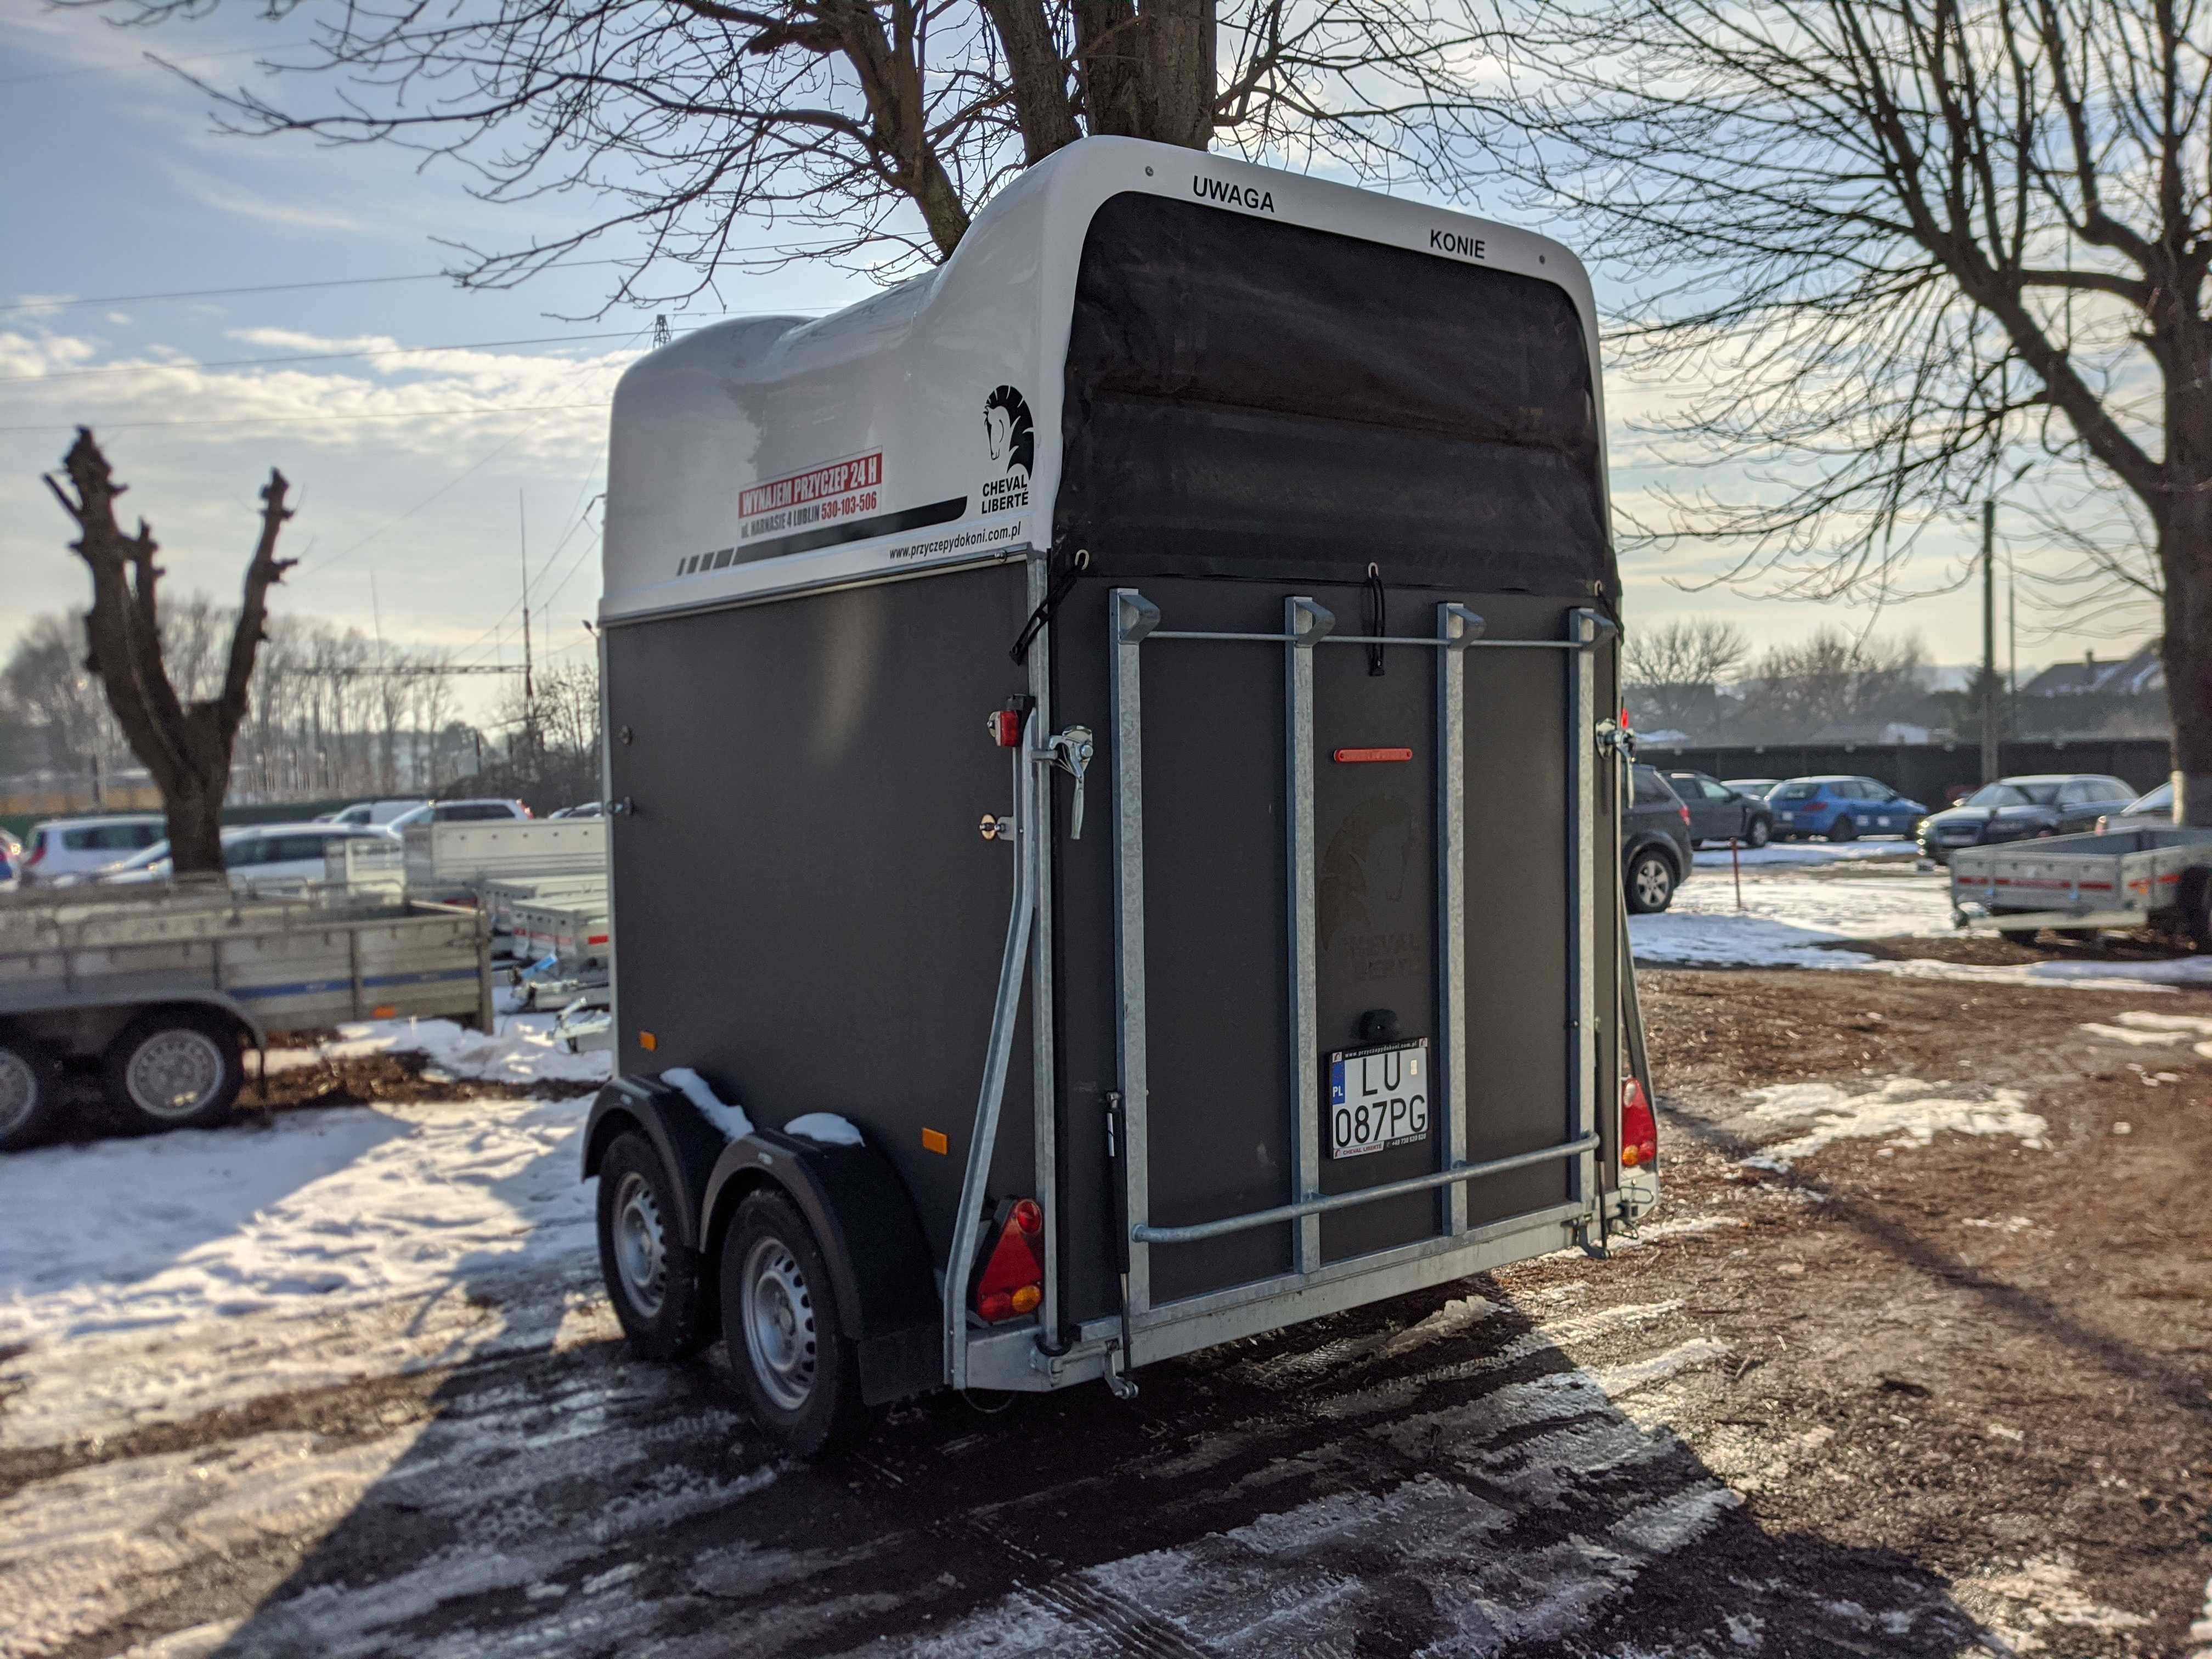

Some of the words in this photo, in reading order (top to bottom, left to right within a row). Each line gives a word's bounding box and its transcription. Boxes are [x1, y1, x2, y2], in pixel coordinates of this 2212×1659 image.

[1193, 176, 1275, 213] UWAGA
[1430, 229, 1485, 259] KONIE
[742, 480, 792, 515] WYNAJEM
[794, 466, 849, 503] PRZYCZEP
[851, 460, 866, 488] 24
[868, 456, 877, 483] H
[981, 488, 1029, 514] LIBERTÉ
[982, 474, 1028, 497] CHEVAL
[787, 511, 792, 527] 4
[793, 504, 820, 527] LUBLIN
[821, 491, 877, 520] 530-103-506
[889, 521, 1022, 558] www.przyczepydokoni.com.pl
[1333, 1086, 1344, 1097] PL
[1363, 1051, 1401, 1096] LU
[1335, 1094, 1425, 1147] 087PG
[1343, 1146, 1362, 1155] CHEVAL
